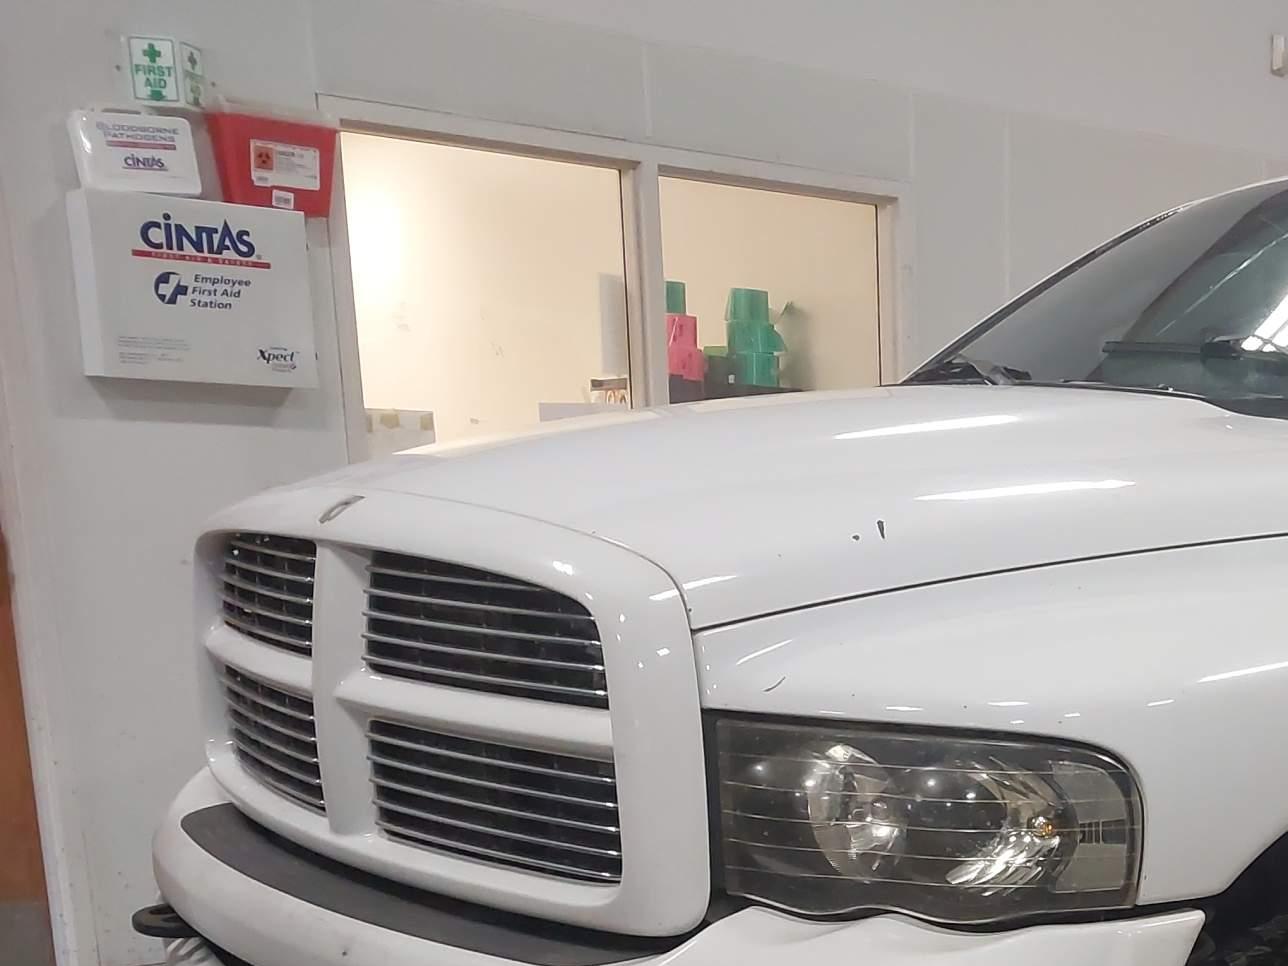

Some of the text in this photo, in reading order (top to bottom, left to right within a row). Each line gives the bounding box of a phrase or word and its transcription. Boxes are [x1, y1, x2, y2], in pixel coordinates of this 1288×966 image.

[134, 64, 172, 77] FIRST
[144, 78, 167, 89] AID
[104, 131, 175, 142] PATHOGENS
[193, 274, 251, 288] Employee
[191, 286, 241, 298] First Aid
[189, 298, 232, 310] Station
[256, 349, 295, 364] Xpect
